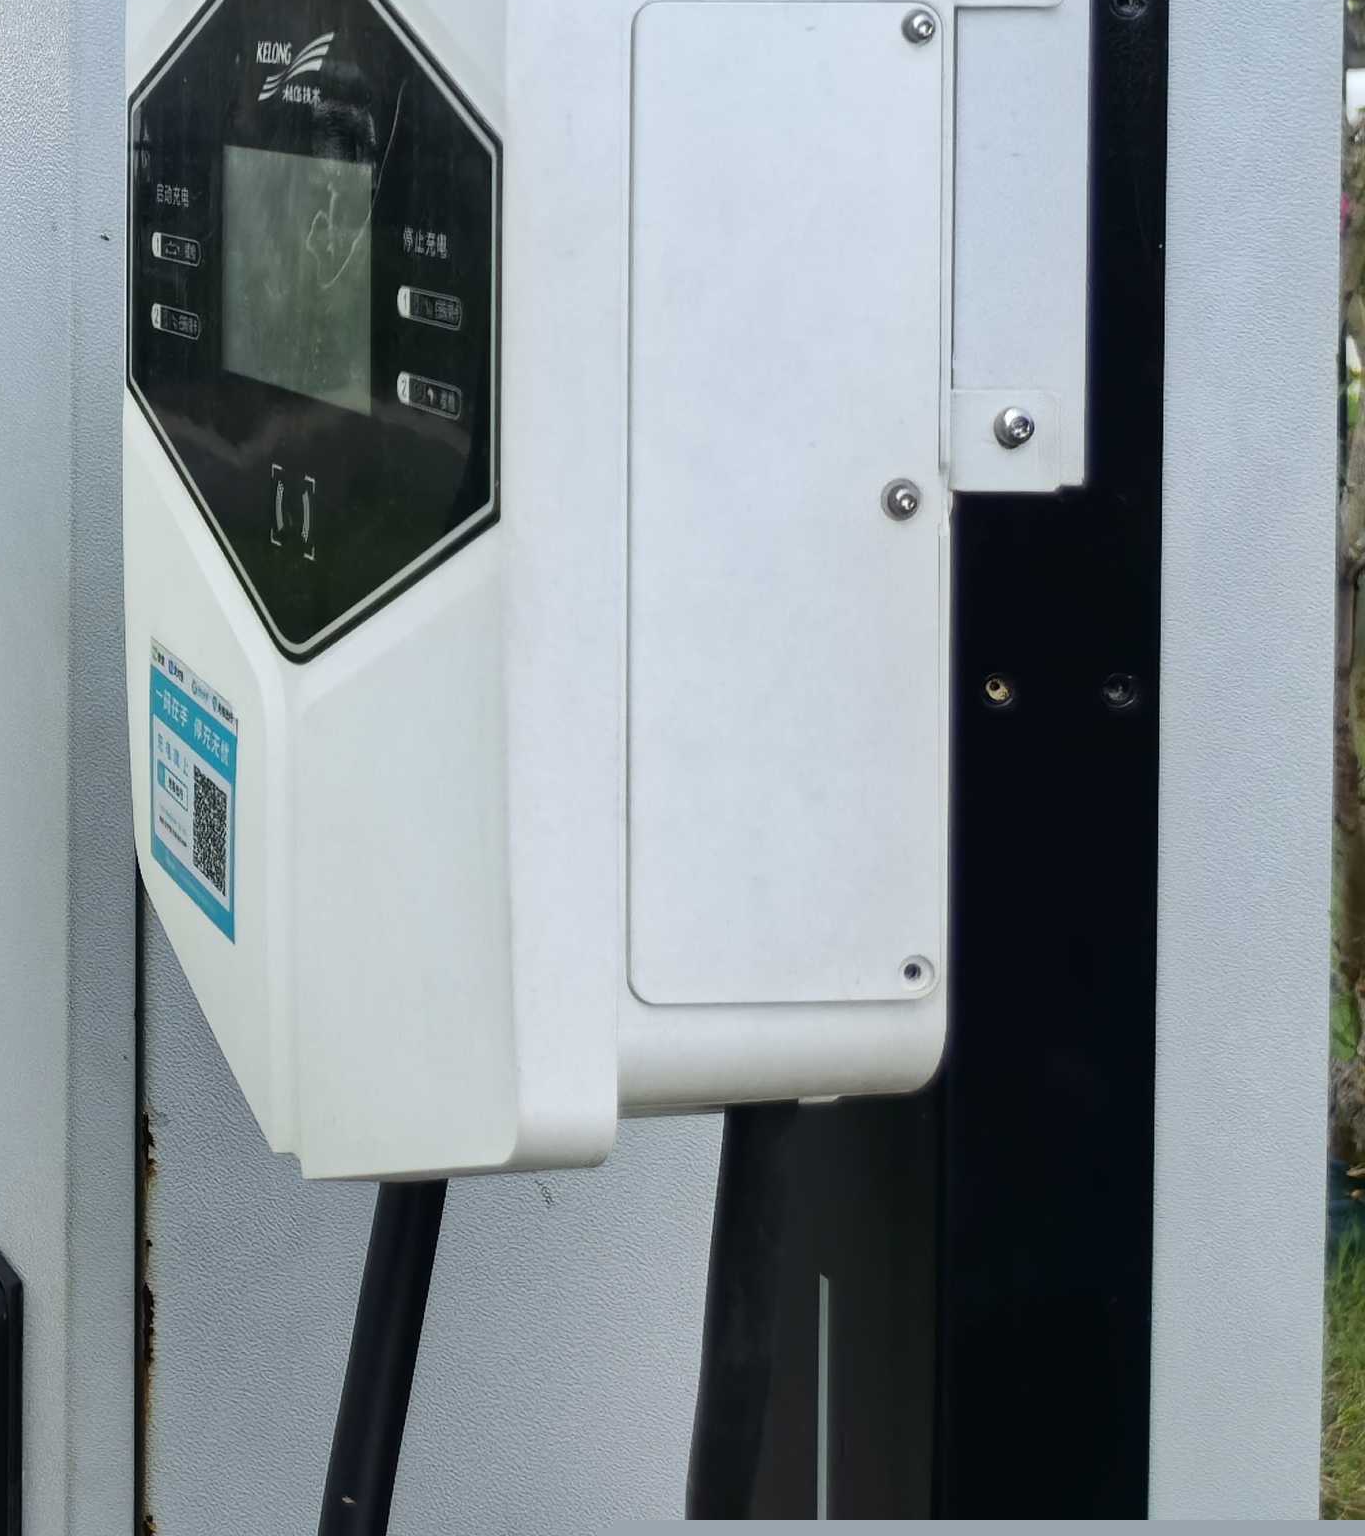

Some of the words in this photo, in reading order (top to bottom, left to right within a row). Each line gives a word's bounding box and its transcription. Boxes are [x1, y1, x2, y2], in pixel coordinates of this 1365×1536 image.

[256, 41, 292, 65] KELONG
[157, 184, 189, 207] 启动充电
[403, 225, 448, 259] 停止充电
